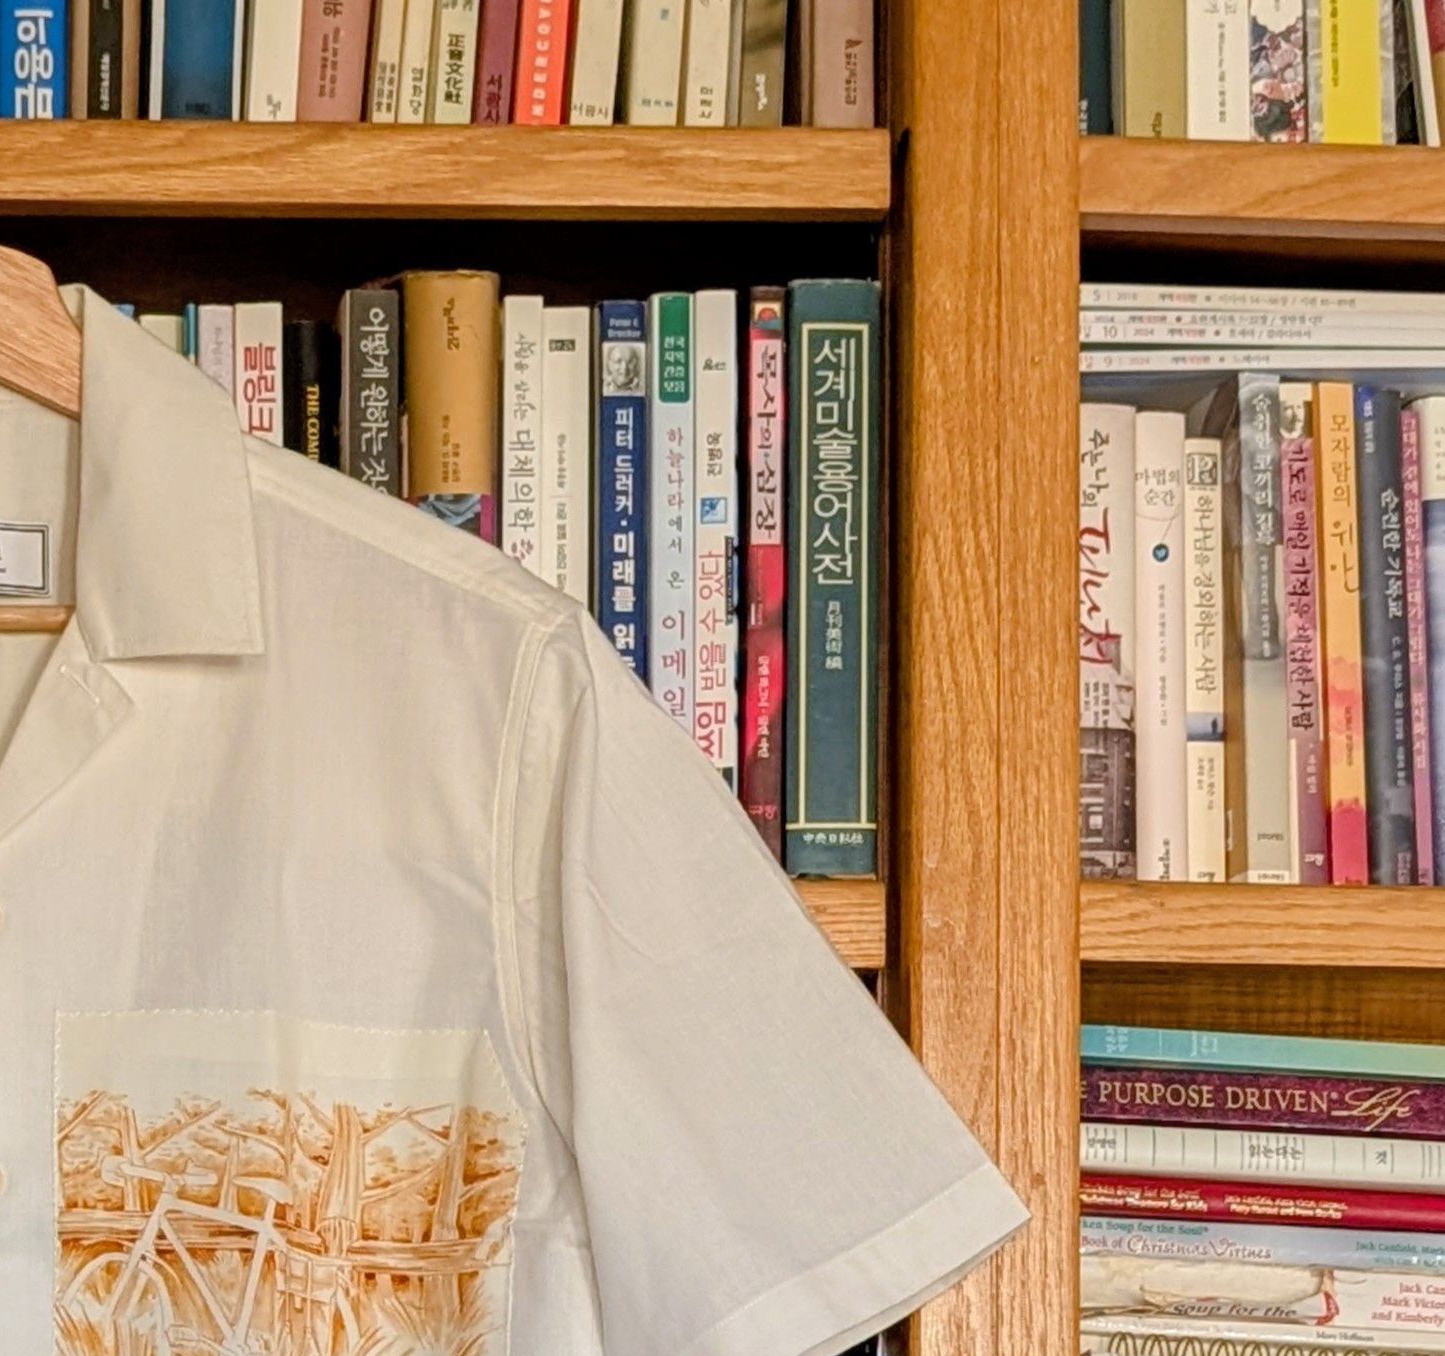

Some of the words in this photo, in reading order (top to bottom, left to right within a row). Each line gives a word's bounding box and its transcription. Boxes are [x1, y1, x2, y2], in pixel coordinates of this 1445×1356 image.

[244, 342, 276, 434] 블링크
[756, 345, 777, 450] 목사의
[706, 432, 723, 477] 전병욱
[813, 338, 857, 585] 세계미술용어사전
[1135, 469, 1181, 485] 마법의
[1329, 413, 1351, 507] 모자람의
[756, 460, 778, 541] 심장
[1144, 489, 1175, 507] 순간
[698, 551, 726, 600] 있다
[699, 609, 726, 633] 수
[661, 610, 688, 718] 이메일
[699, 641, 727, 691] 받을
[1194, 655, 1216, 693] 사람
[695, 701, 727, 759] 쓰임
[1099, 1081, 1215, 1108] PURPOSE
[1225, 1086, 1330, 1113] DRIVEN
[1332, 1087, 1420, 1131] Life
[1106, 1221, 1133, 1235] Soup
[1136, 1221, 1154, 1233] for
[1156, 1222, 1175, 1234] the
[1111, 1236, 1123, 1249] of
[1126, 1235, 1209, 1255] Christmas
[1209, 1237, 1272, 1260] Virtues
[1227, 1300, 1256, 1316] for
[1262, 1302, 1296, 1317] the
[1382, 1296, 1409, 1308] Mark
[1399, 1282, 1424, 1295] Jack
[1371, 1310, 1391, 1321] and
[1396, 1311, 1444, 1326] Kimberly
